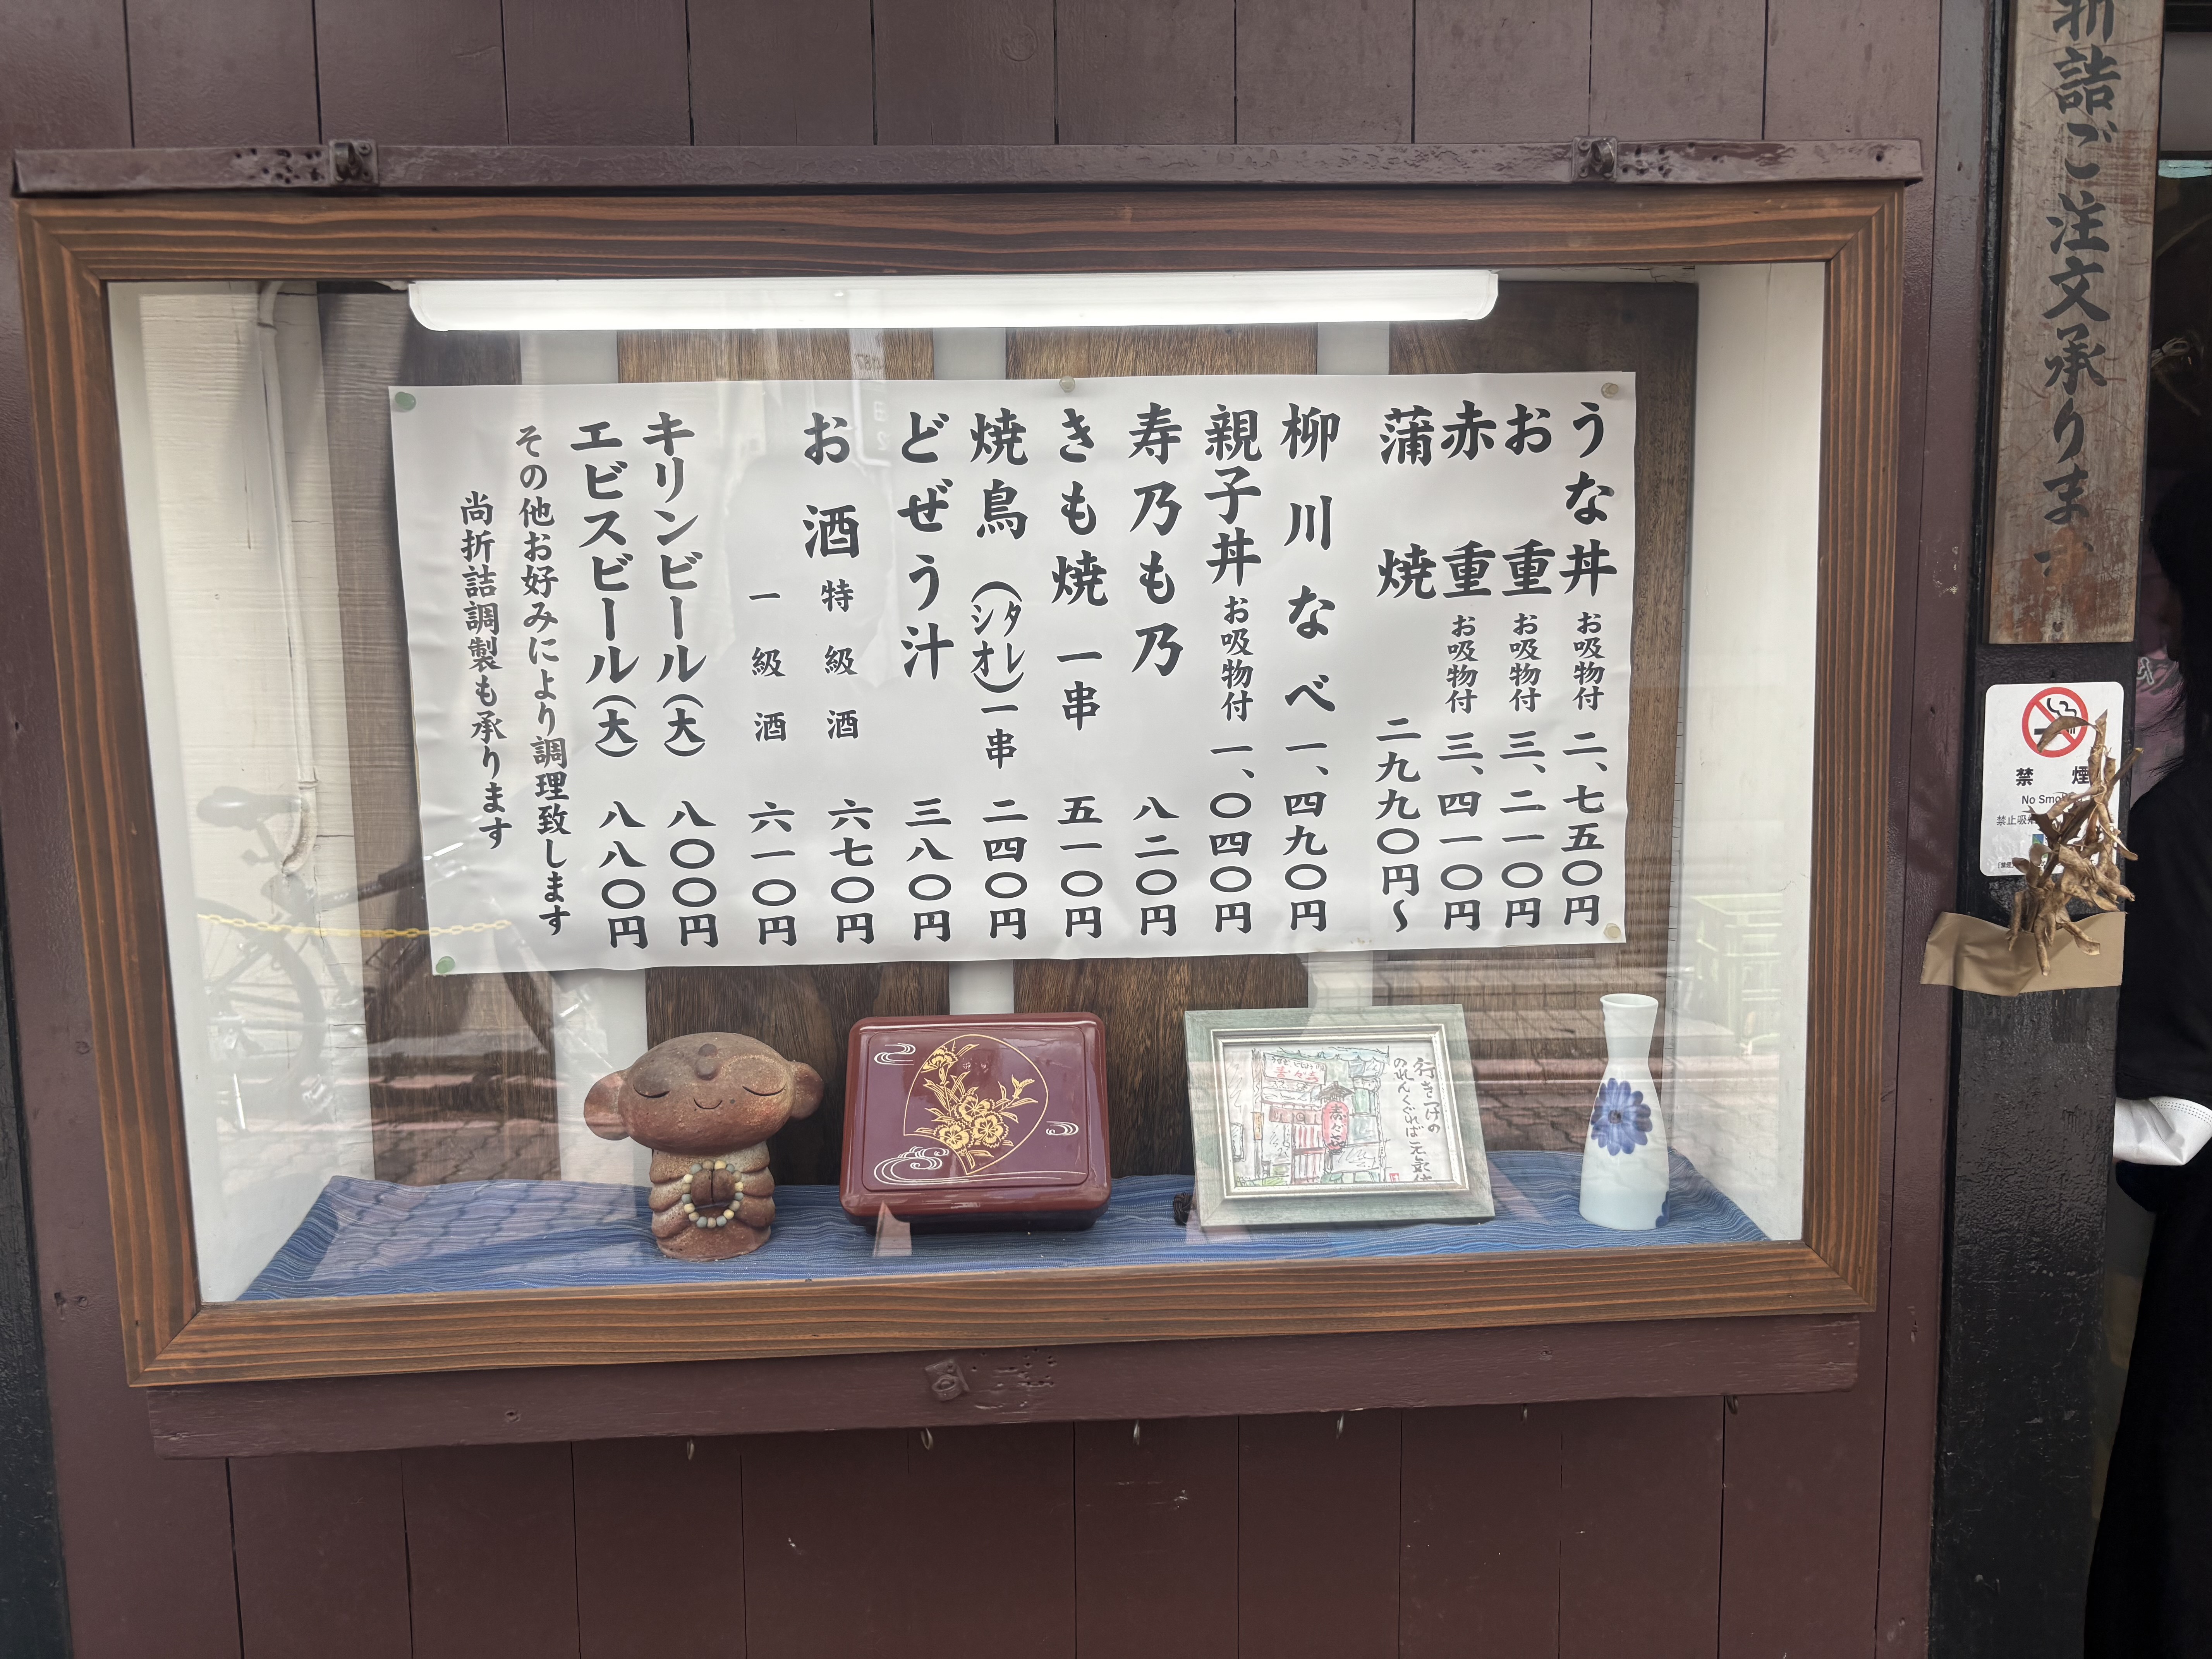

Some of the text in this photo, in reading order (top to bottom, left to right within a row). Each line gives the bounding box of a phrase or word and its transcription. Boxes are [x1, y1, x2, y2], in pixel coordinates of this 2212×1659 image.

[460, 490, 513, 850] 尚折詰調製も承ります
[515, 425, 572, 936] その他お好みにより調理致します
[2021, 795, 2035, 804] No
